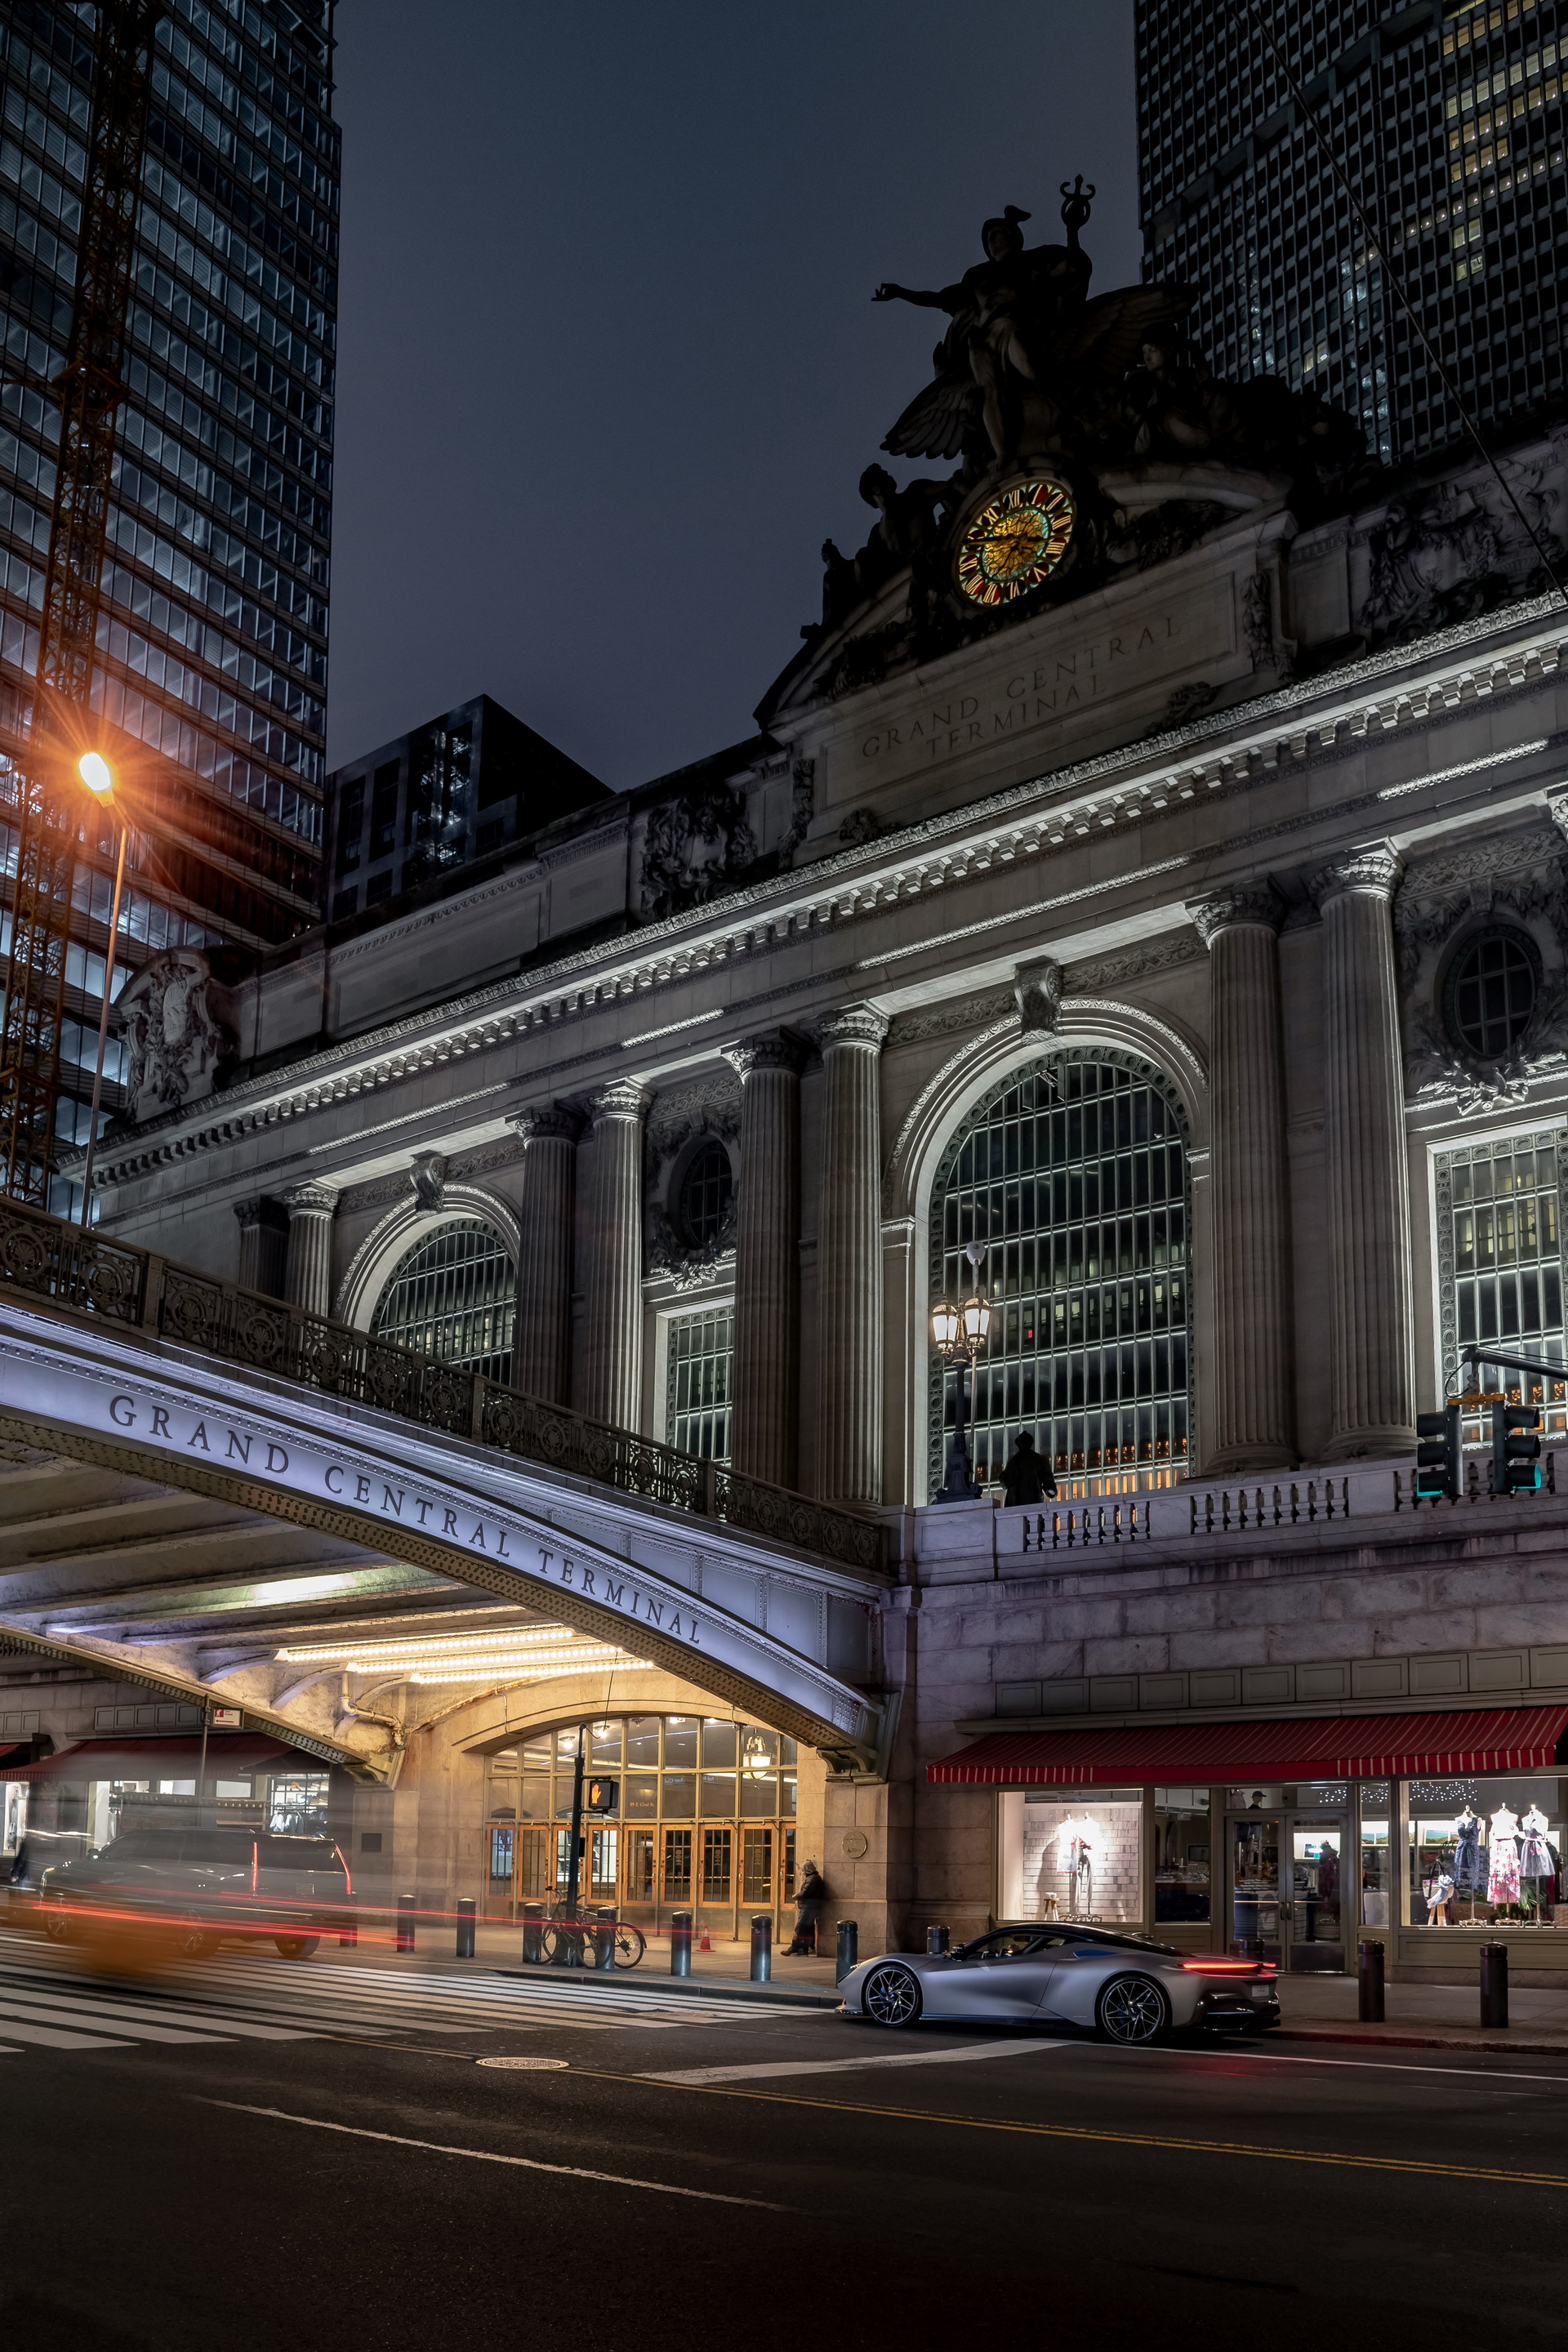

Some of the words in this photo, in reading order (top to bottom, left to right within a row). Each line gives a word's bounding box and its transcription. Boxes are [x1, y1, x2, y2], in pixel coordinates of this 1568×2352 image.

[1008, 489, 1021, 510] XII
[1045, 492, 1064, 511] II
[983, 507, 1000, 526] XI
[1052, 514, 1071, 531] III
[1045, 541, 1066, 555] IIII
[1033, 567, 1048, 583] V
[862, 697, 979, 758] GRAND
[1006, 617, 1182, 699] CENTRAL
[926, 675, 1107, 759] TERMINAL
[109, 1395, 289, 1474] GRAND
[324, 1465, 510, 1558] CENTRAL
[538, 1548, 701, 1645] TERMINAL
